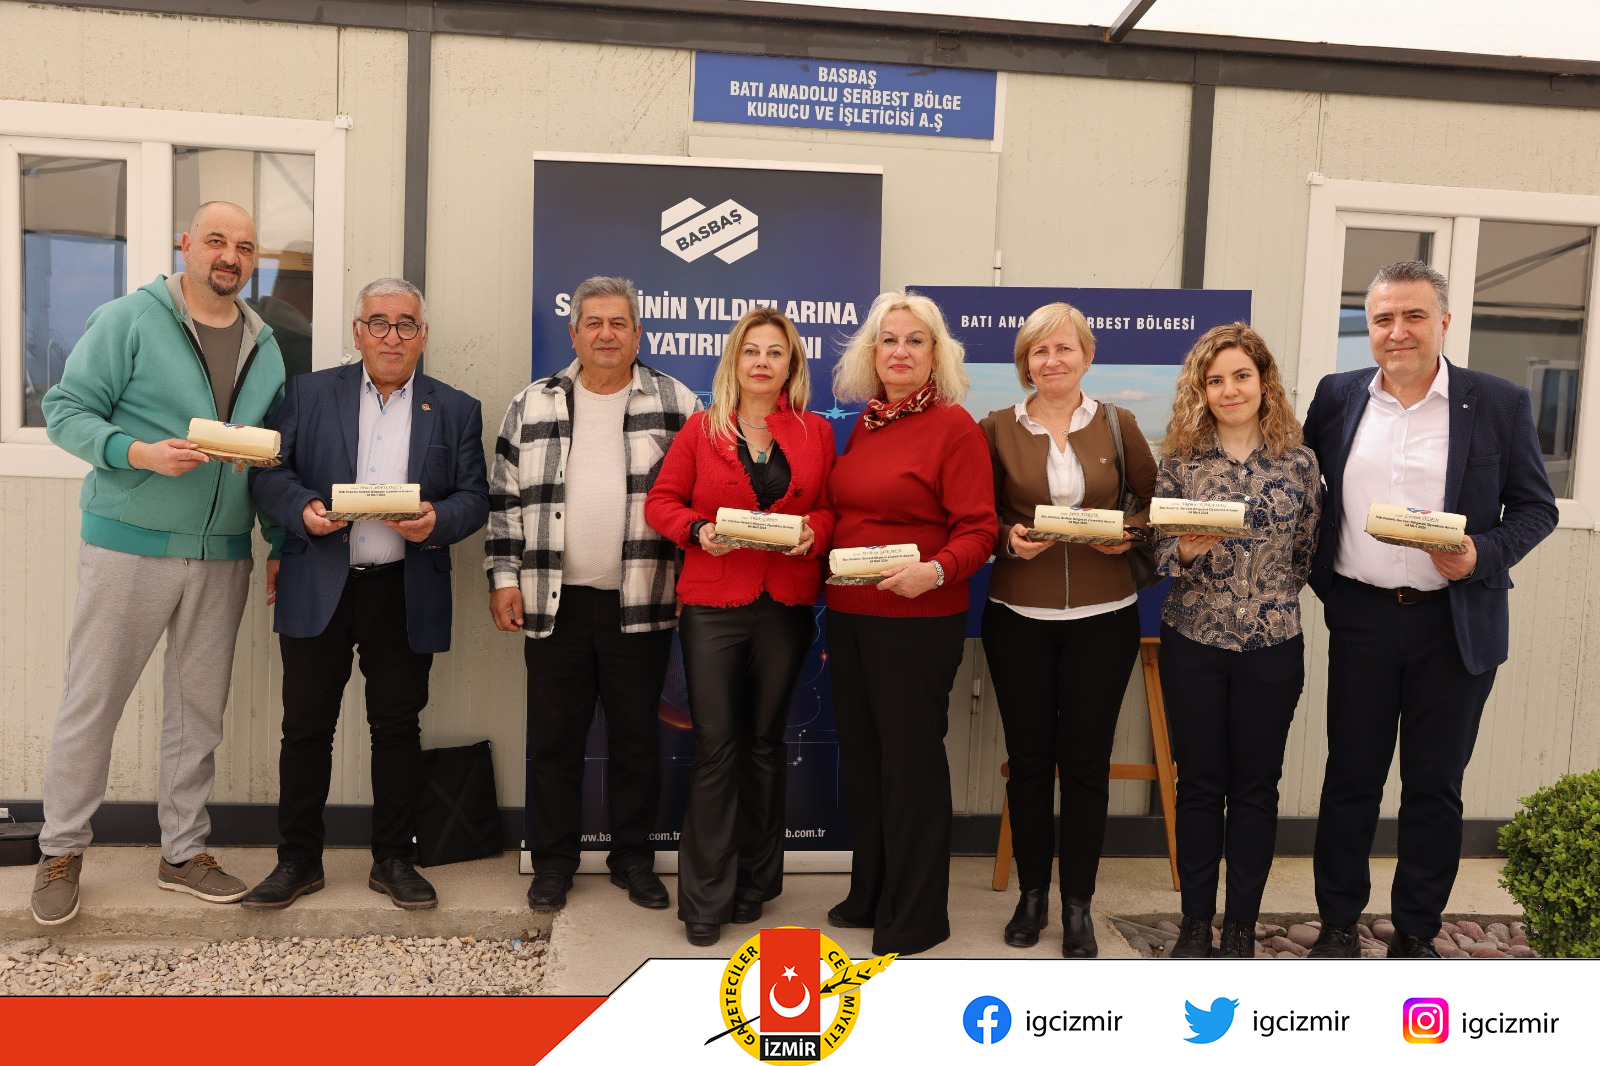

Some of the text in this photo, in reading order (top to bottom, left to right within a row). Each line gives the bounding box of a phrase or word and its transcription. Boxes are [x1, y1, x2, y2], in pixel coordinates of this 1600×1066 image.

[818, 66, 877, 89] BASBAŞ
[730, 80, 962, 111] BATI ANADOLU SERBEST BÖLGE
[747, 101, 943, 132] KURUCU VE İŞLETİCİSİ A.Ş
[676, 208, 743, 252] BASBAŞ
[555, 290, 687, 320] SİNİN
[961, 315, 992, 328] BATI
[1088, 316, 1131, 330] RBEST
[1136, 314, 1195, 331] BÖLGESİ
[646, 332, 729, 357] YATIRI
